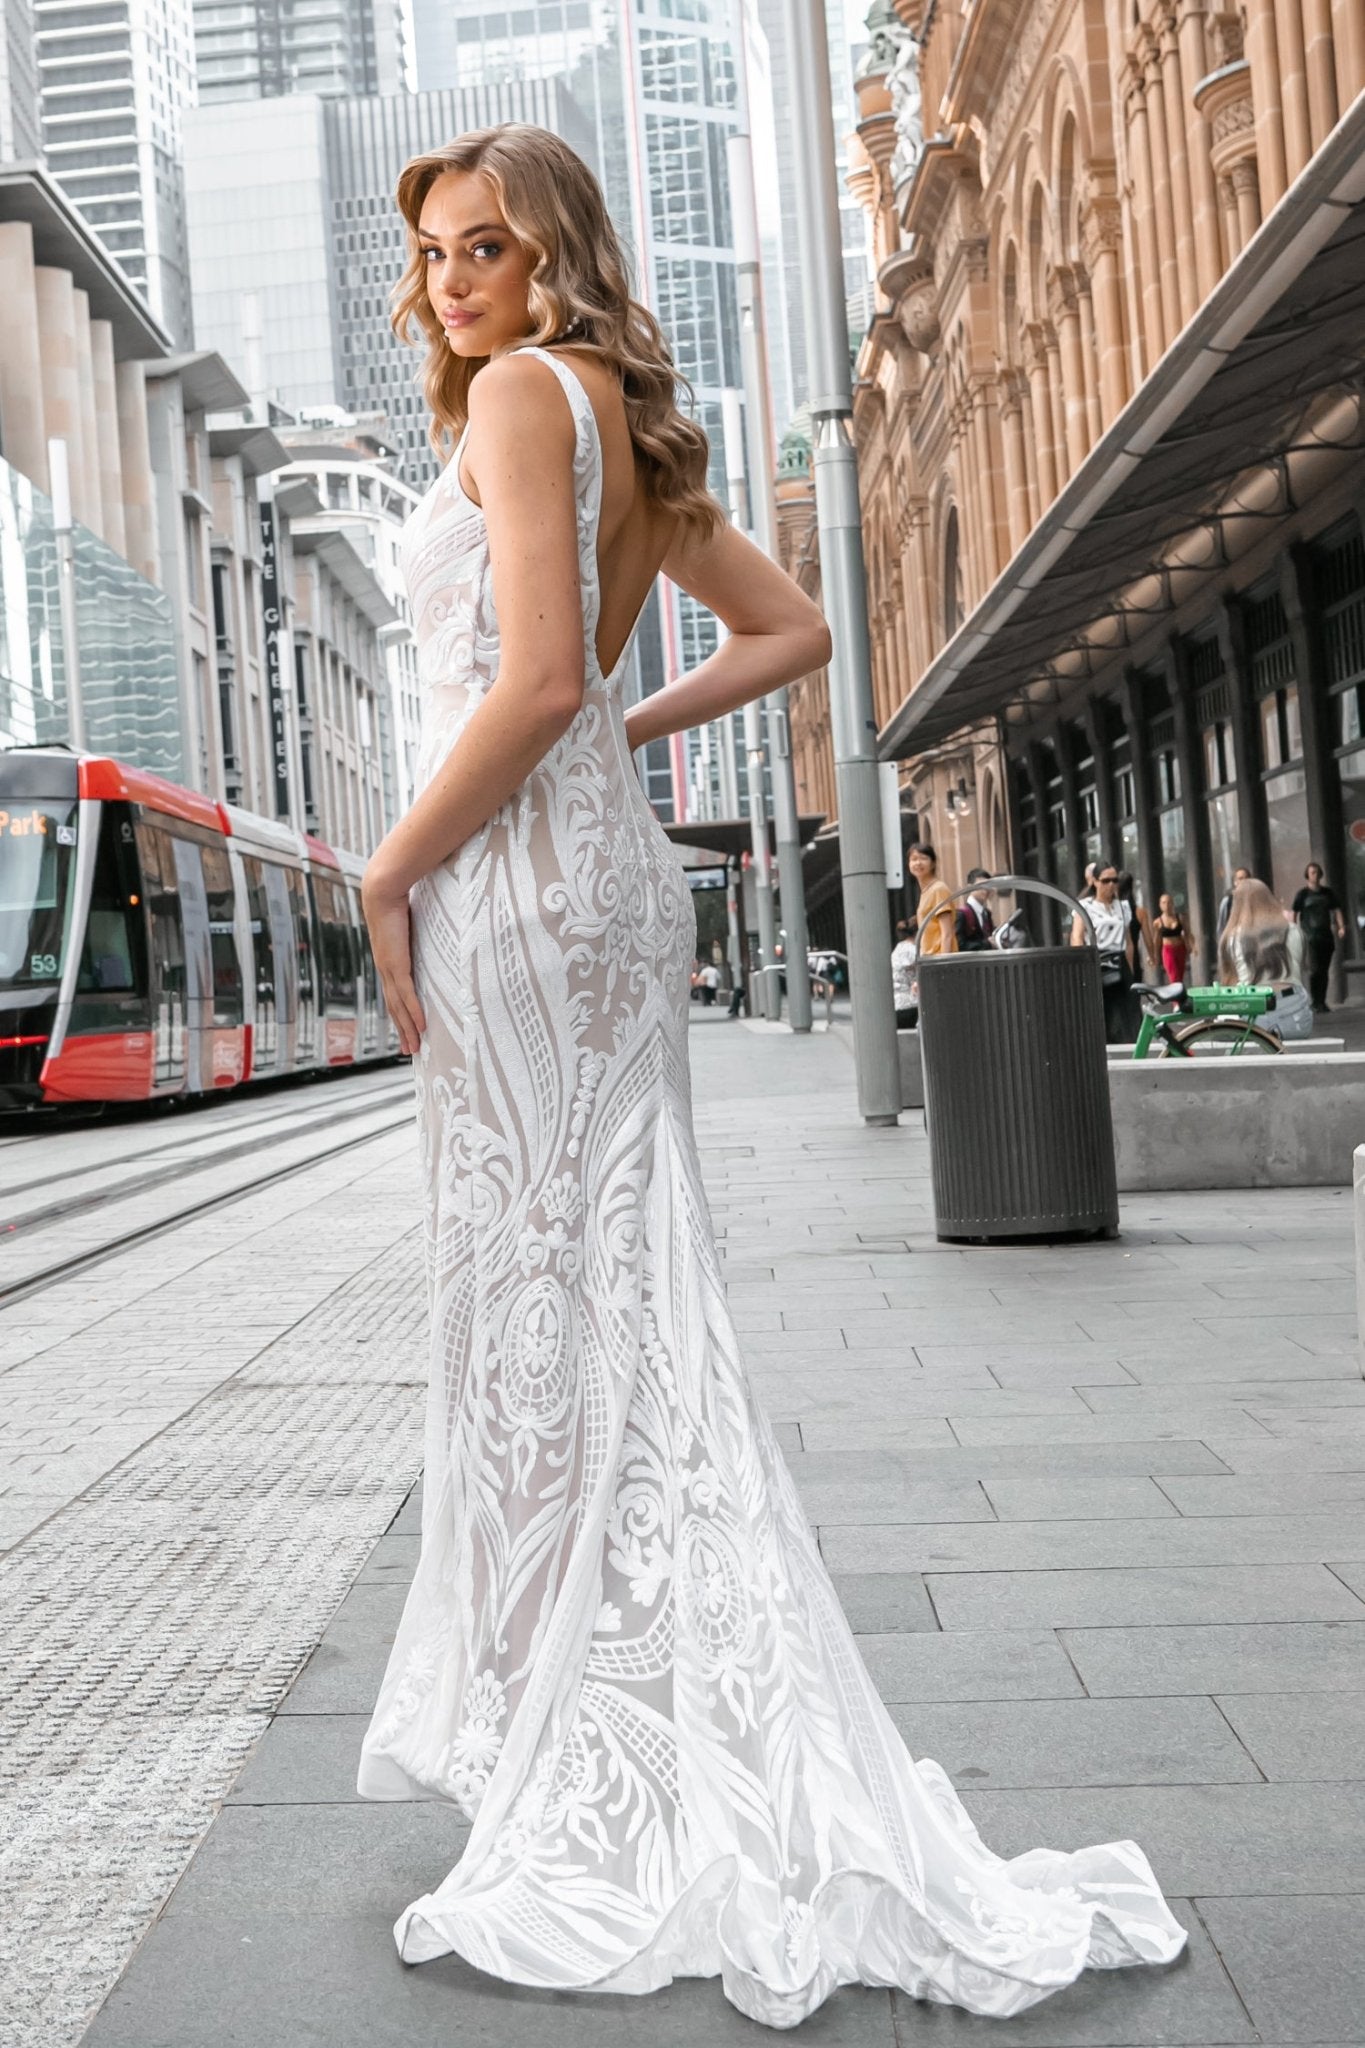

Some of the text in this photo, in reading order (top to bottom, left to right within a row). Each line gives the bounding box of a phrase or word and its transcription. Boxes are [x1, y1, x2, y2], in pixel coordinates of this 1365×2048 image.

[260, 521, 288, 779] THE GALERIES
[0, 809, 48, 837] Park
[31, 954, 57, 973] 53
